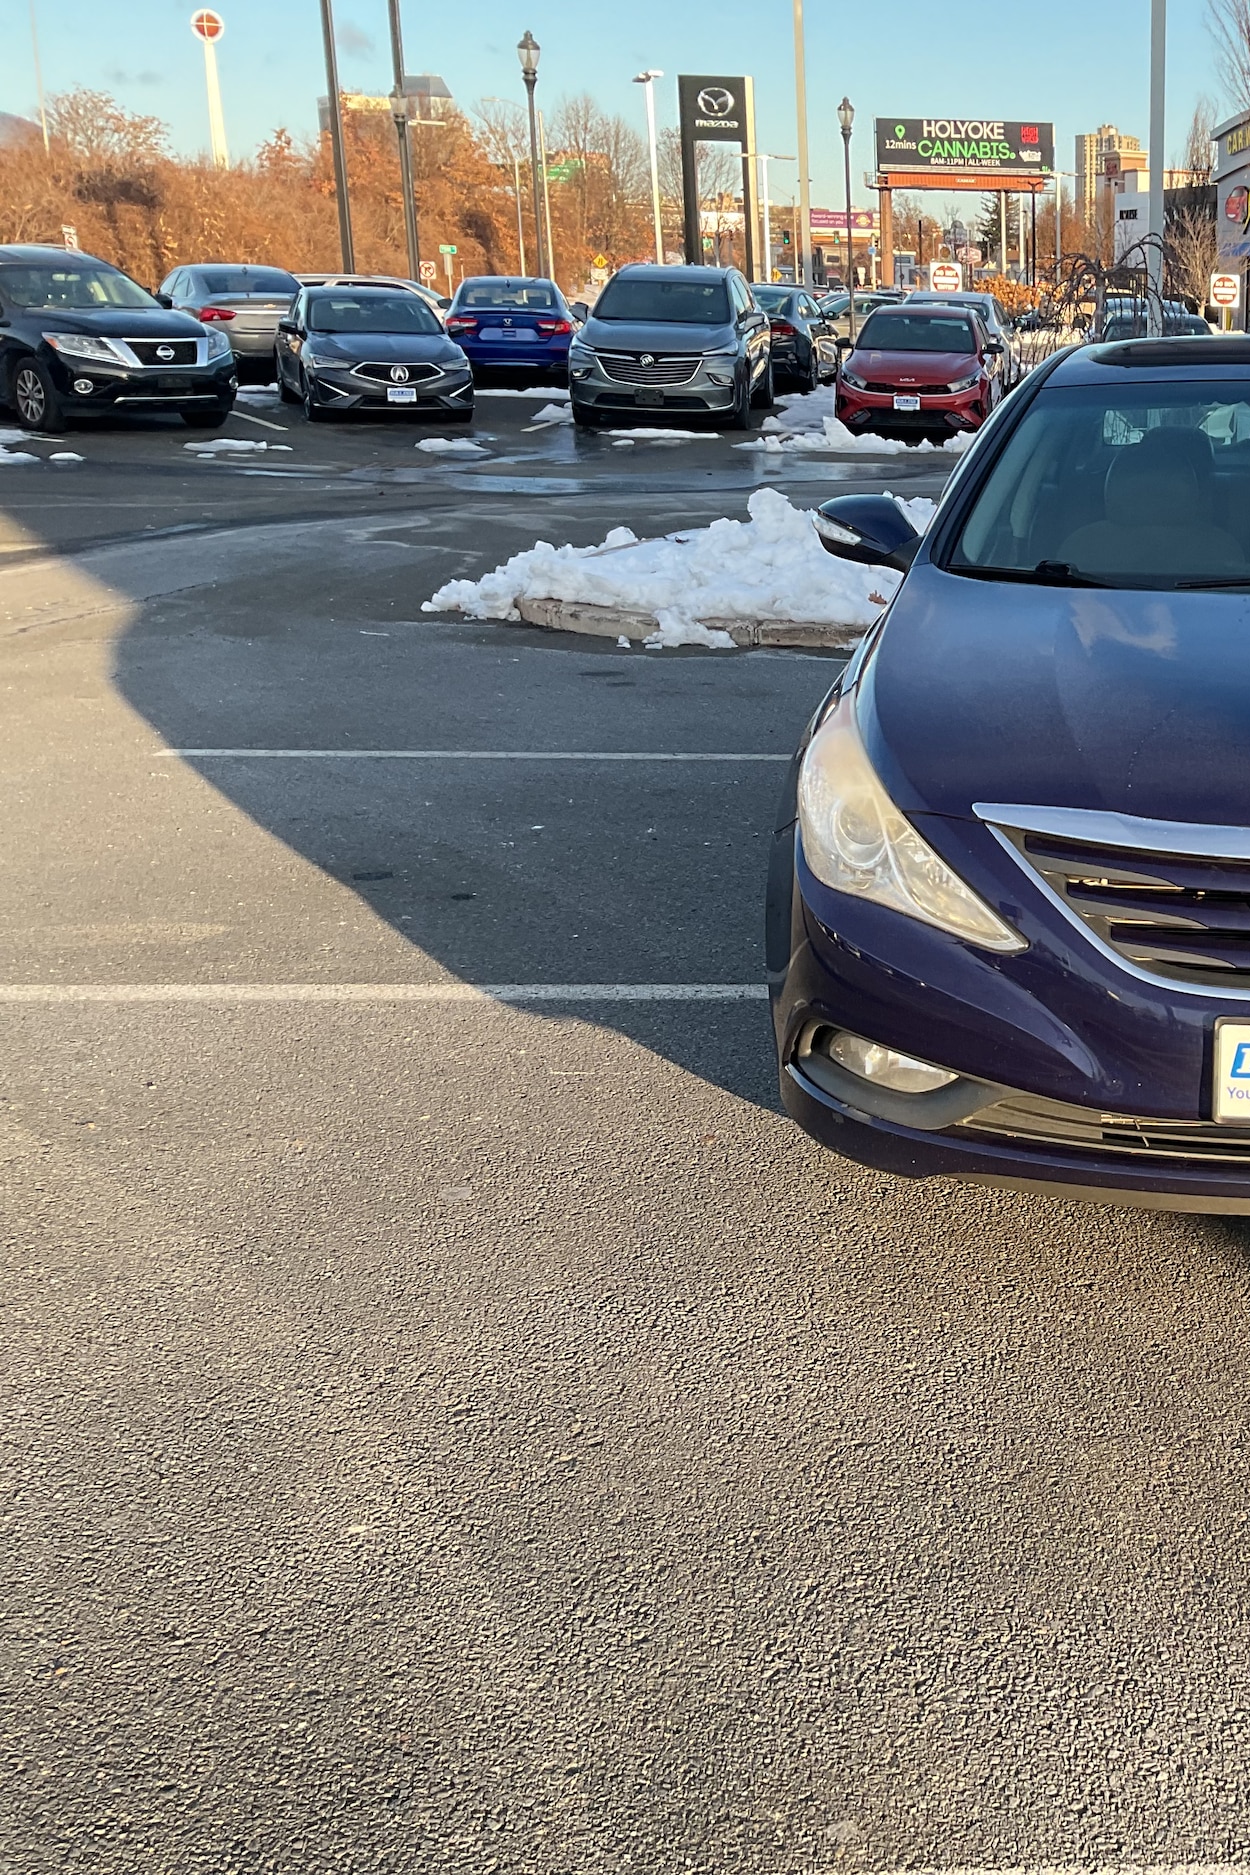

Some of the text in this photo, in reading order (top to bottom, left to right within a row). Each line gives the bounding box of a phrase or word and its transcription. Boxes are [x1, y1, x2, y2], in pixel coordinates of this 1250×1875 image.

[695, 119, 739, 129] mazda
[922, 119, 1005, 140] HOLYOKE
[885, 139, 917, 150] 12mins
[1226, 130, 1245, 155] CAR
[930, 157, 1001, 167] 8AM-11PM ALL-WEEK
